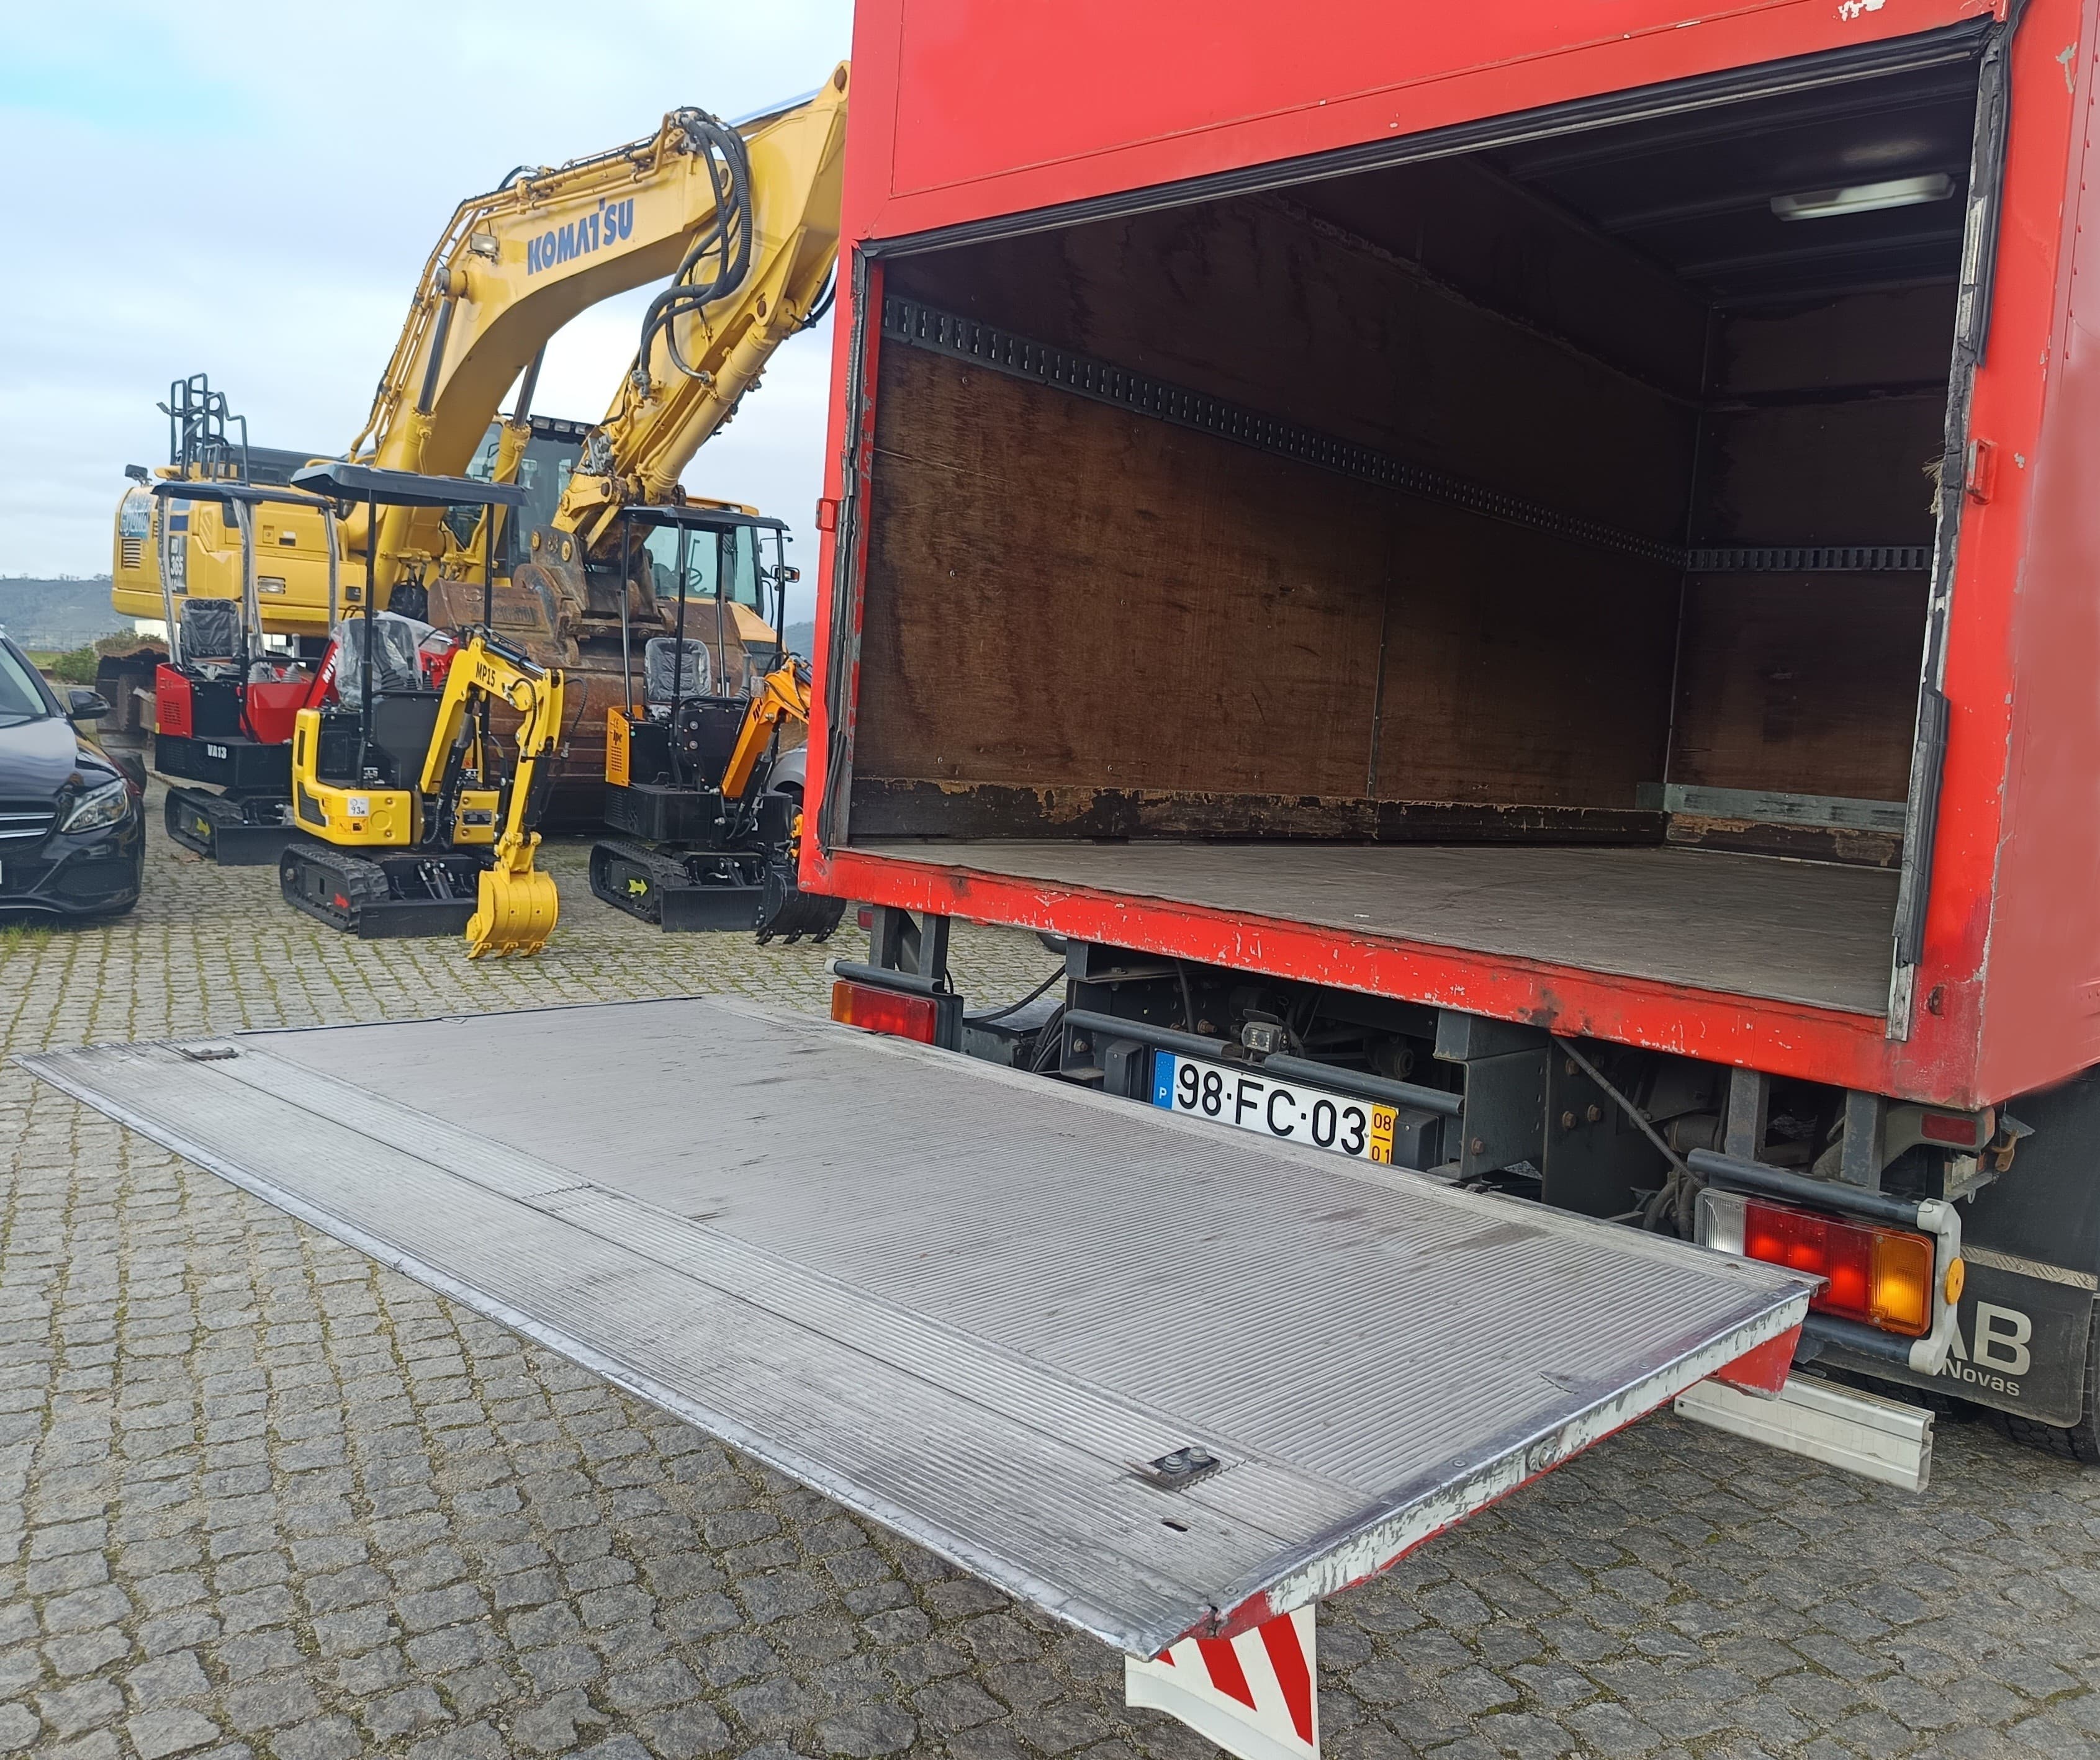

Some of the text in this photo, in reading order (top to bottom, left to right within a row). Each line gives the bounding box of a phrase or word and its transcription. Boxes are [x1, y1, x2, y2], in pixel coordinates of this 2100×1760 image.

[528, 197, 634, 276] KOMATSU
[475, 661, 496, 688] MP15
[207, 743, 227, 759] VA13
[1159, 1089, 1167, 1099] P
[1374, 1112, 1392, 1131] 08
[1372, 1146, 1390, 1164] 01
[1942, 1358, 2020, 1396] Novas
